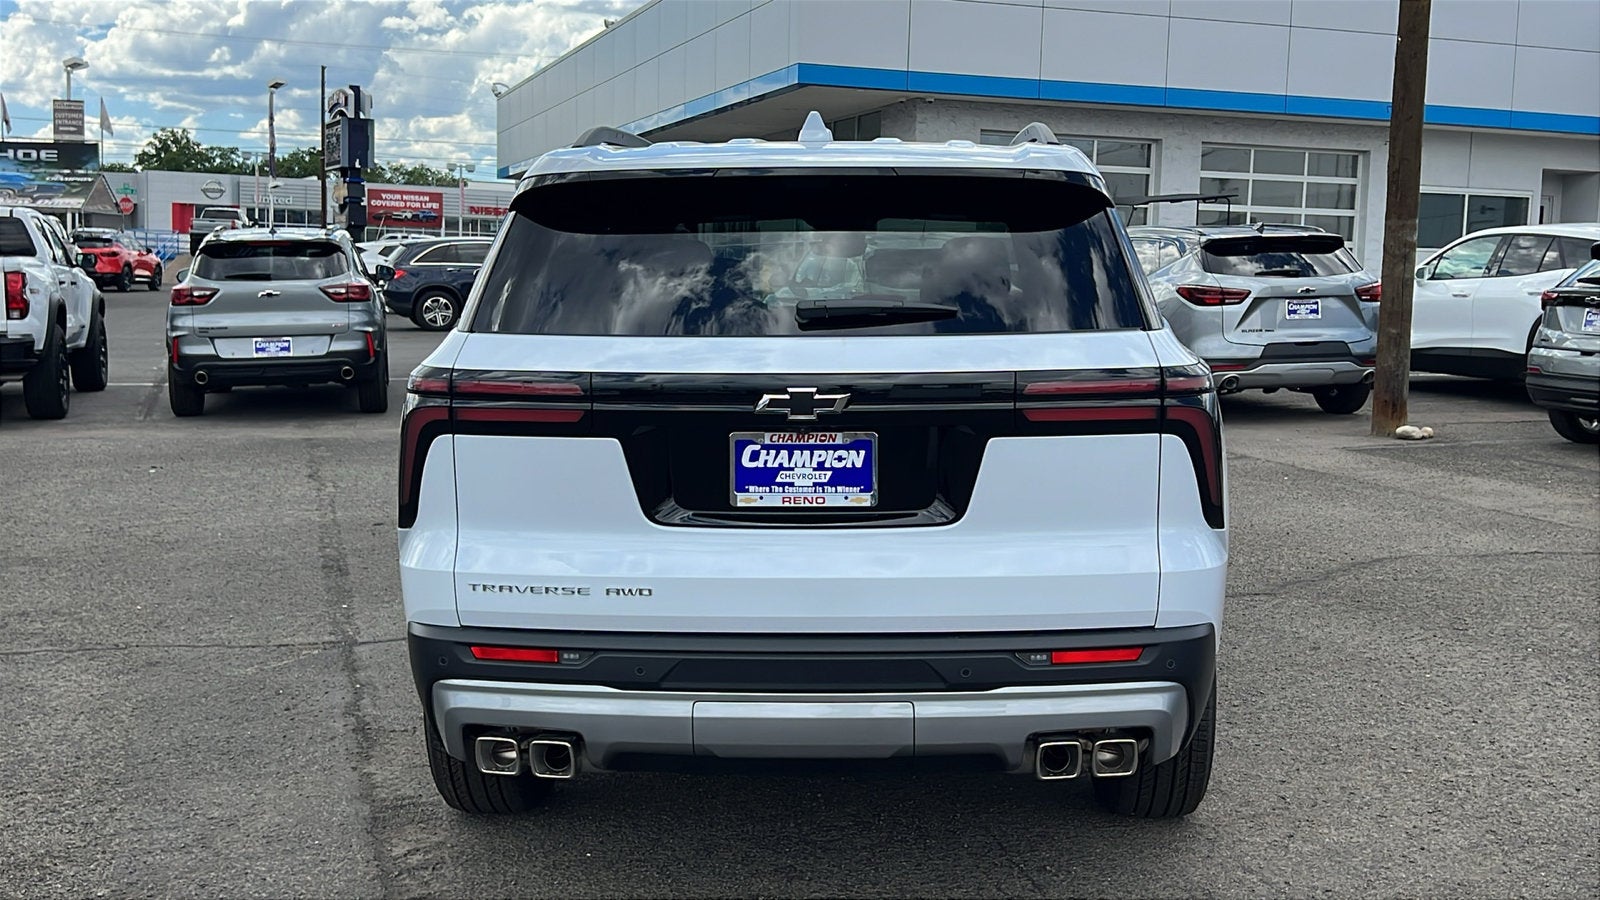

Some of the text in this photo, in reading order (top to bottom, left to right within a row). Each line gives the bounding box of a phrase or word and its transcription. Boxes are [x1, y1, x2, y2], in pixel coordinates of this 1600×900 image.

[253, 194, 293, 205] Unted
[402, 194, 430, 202] NISSAN
[370, 199, 405, 208] COVERED
[769, 433, 838, 443] CHAMPION
[741, 444, 866, 468] CHAMPION
[779, 472, 828, 480] CHEVROLET
[771, 485, 783, 493] The
[784, 485, 816, 493] Customer
[824, 485, 836, 493] The
[781, 496, 826, 505] RENO
[468, 583, 653, 597] TRAVERSE AWD
